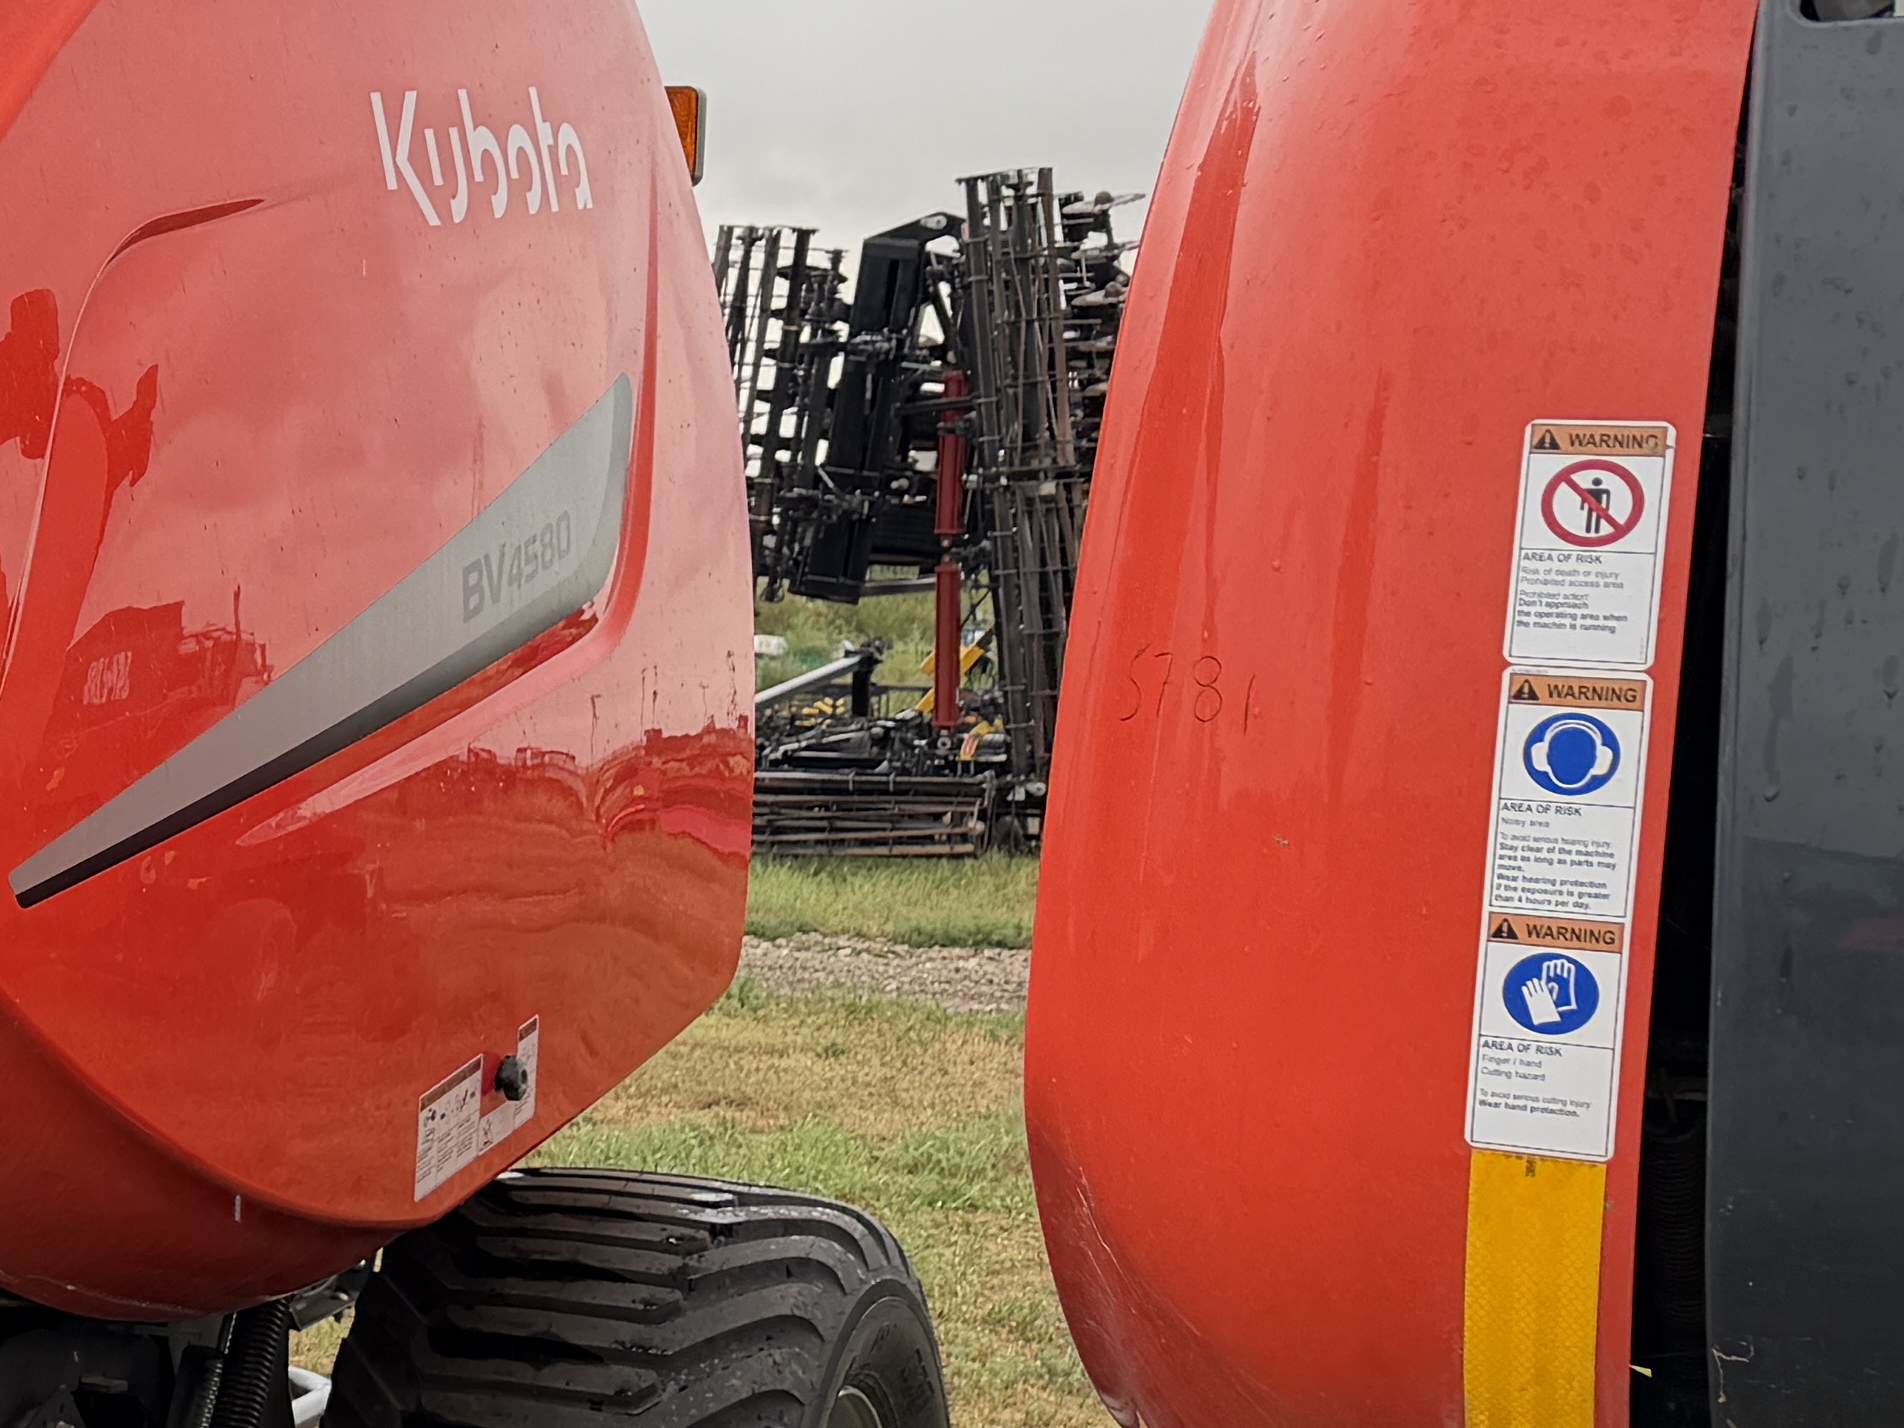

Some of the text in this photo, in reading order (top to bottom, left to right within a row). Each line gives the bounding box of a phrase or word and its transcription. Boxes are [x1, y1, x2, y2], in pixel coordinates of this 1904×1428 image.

[370, 87, 592, 226] Kubota
[1569, 433, 1658, 450] WARNING
[462, 510, 570, 624] BV4580
[1523, 552, 1602, 564] AREA OF RISK
[1120, 643, 1256, 735] 5781
[1547, 683, 1637, 703] WARNING
[1501, 803, 1581, 816] AREA OF RISK
[1526, 923, 1616, 945] WARNING
[1482, 1040, 1562, 1057] AREA OF RISK
